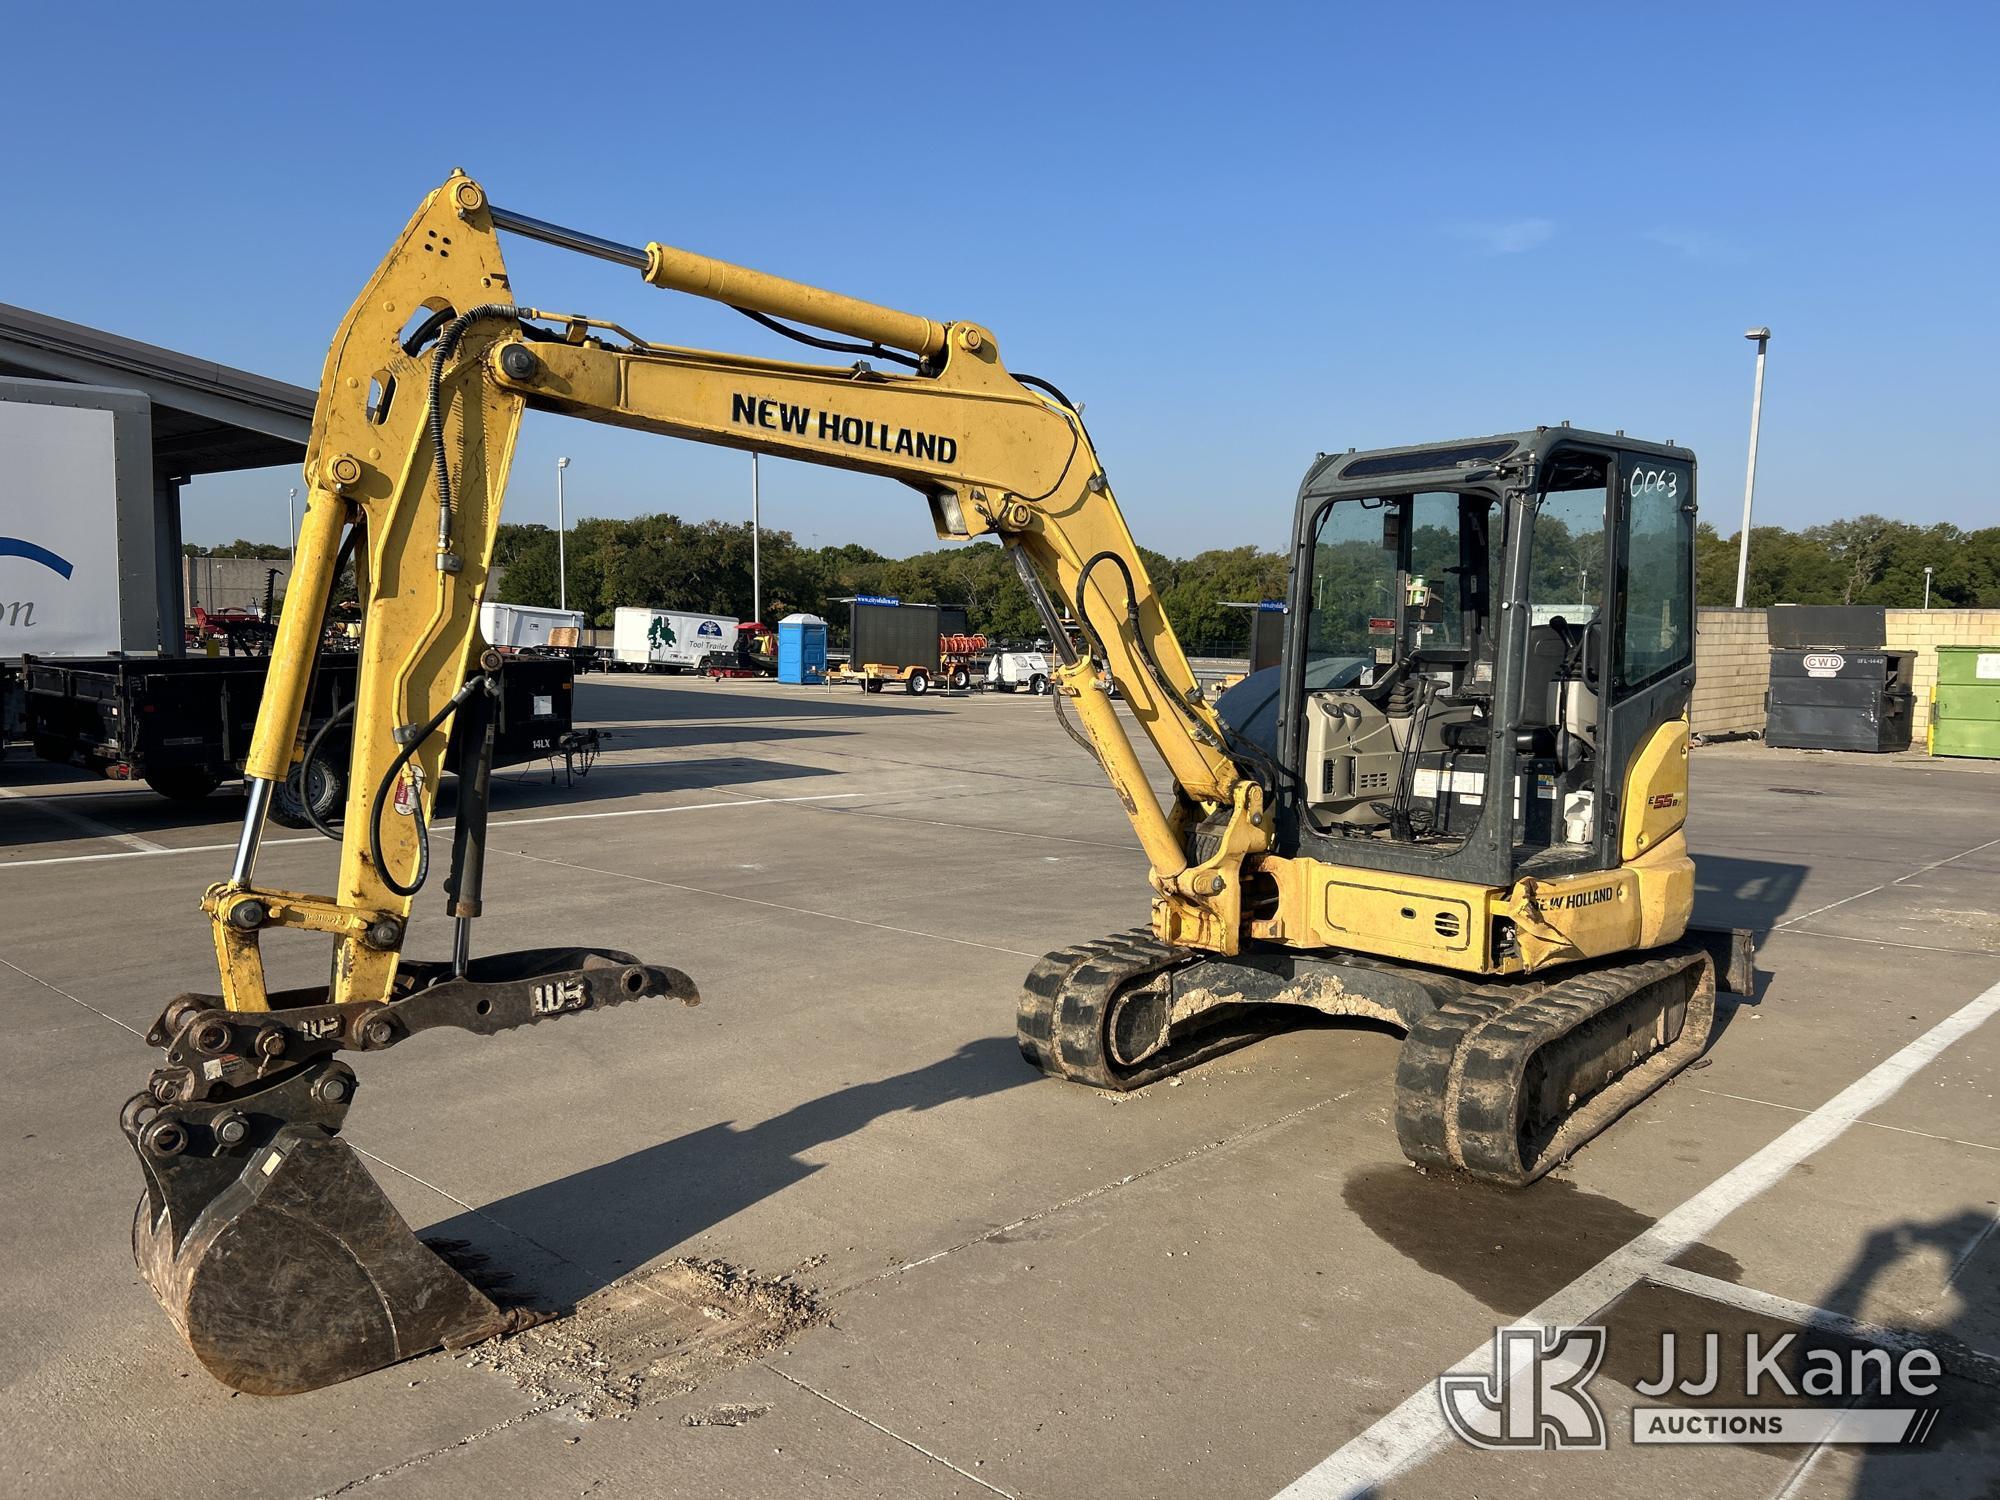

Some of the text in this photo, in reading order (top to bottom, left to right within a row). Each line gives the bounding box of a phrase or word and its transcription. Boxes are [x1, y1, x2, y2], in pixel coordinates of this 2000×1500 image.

[732, 392, 957, 464] NEW HOLLAND
[1630, 467, 1677, 498] 0063
[689, 640, 729, 650] Tool Trailer
[1808, 658, 1839, 667] CWD
[532, 739, 551, 749] 14LX
[1565, 887, 1613, 909] HOLLAND
